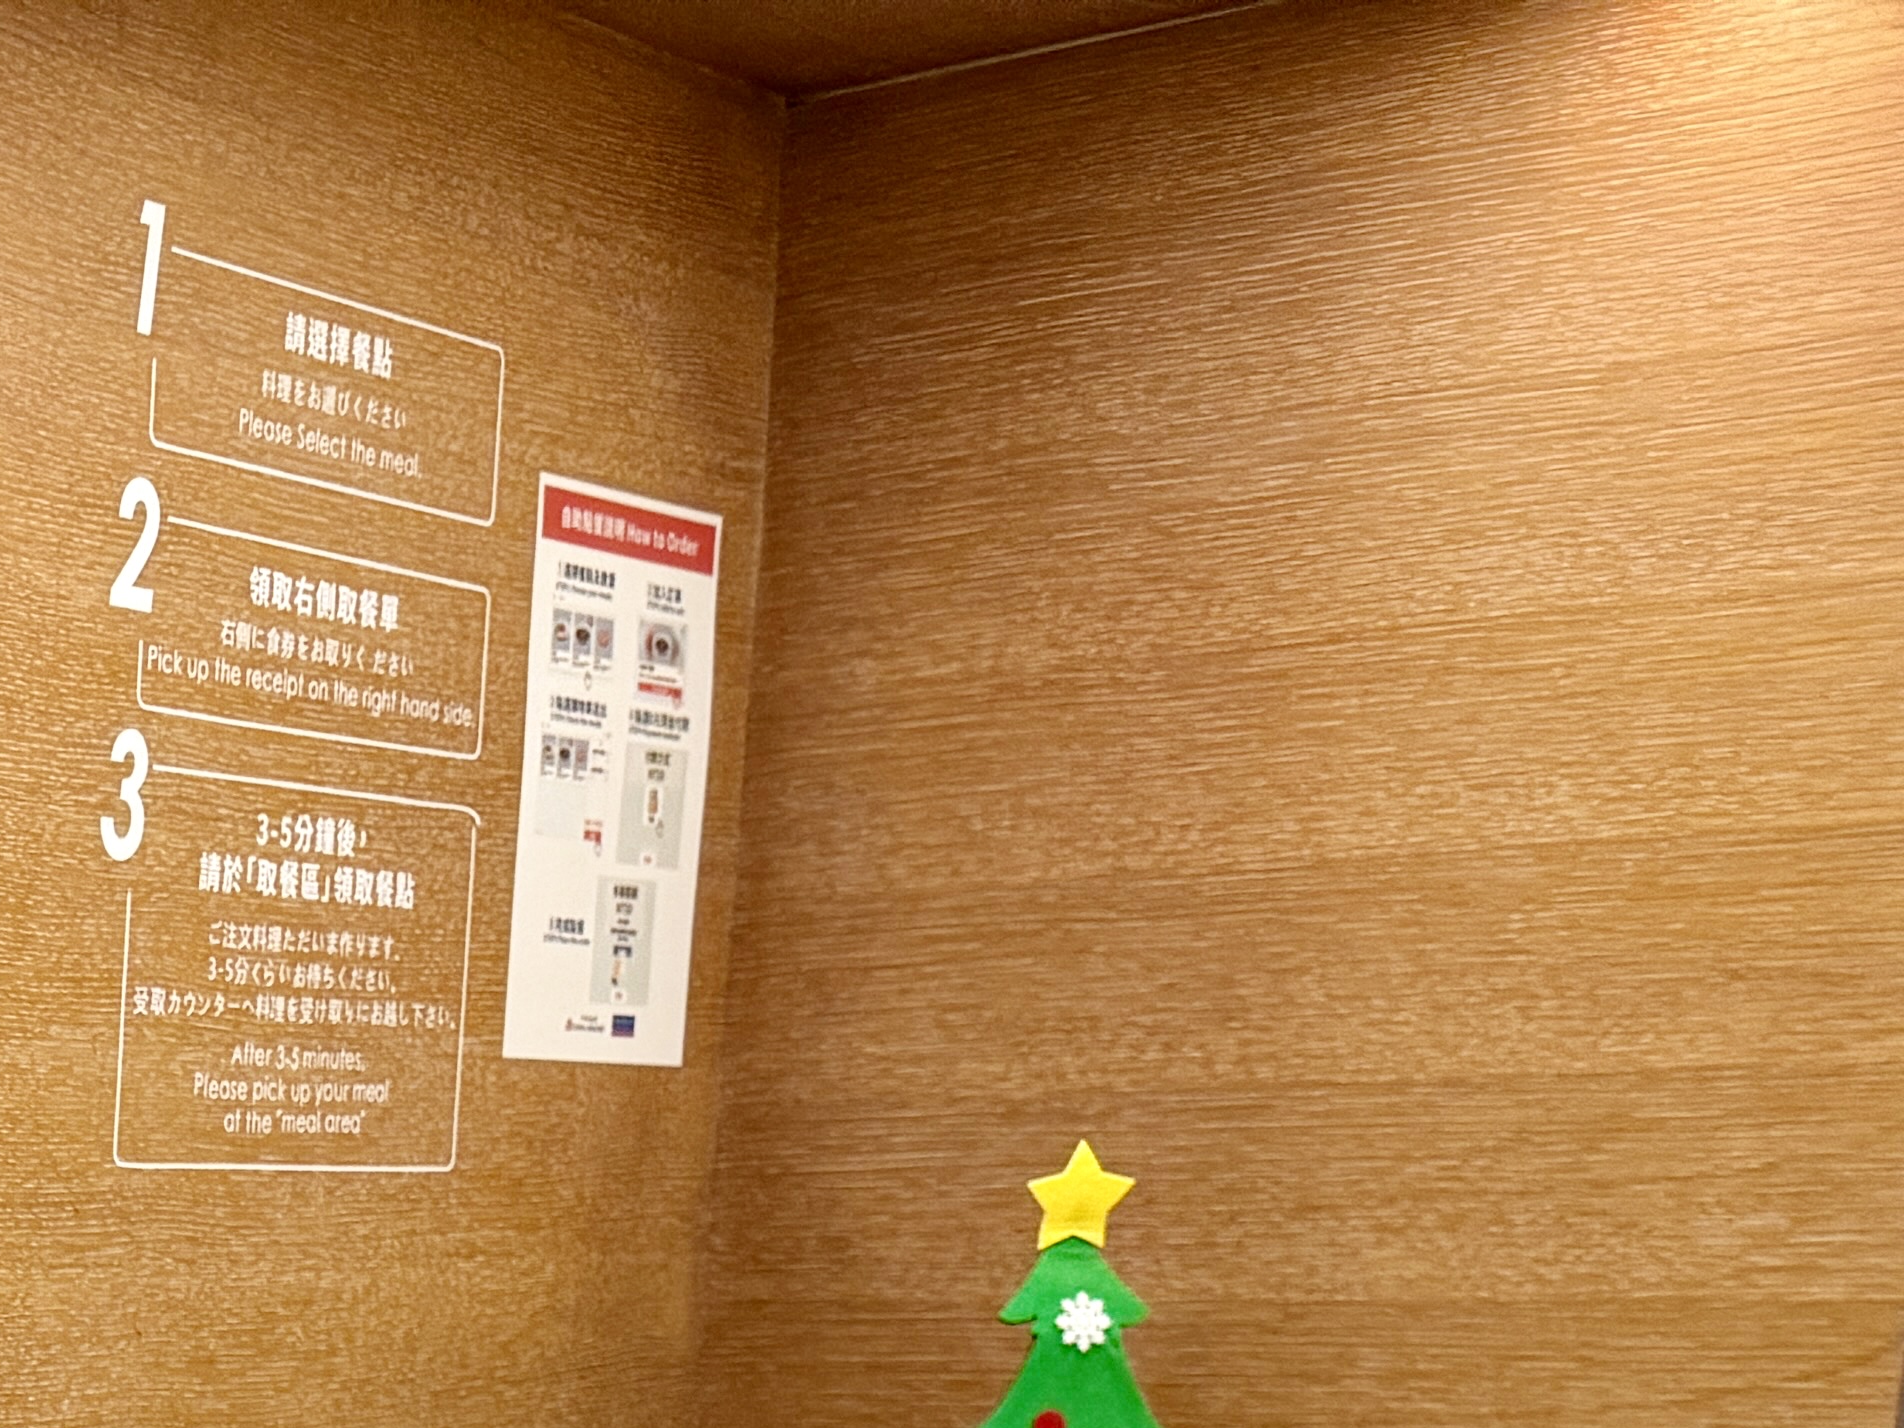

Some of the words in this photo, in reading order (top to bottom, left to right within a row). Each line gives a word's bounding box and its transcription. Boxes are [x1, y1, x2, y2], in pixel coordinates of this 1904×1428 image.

[137, 199, 166, 335] 1
[285, 311, 393, 380] 請選擇餐點
[262, 368, 406, 429] 料理をお選びください
[239, 407, 292, 445] Please
[297, 423, 346, 459] Select
[351, 436, 376, 467] the
[379, 450, 423, 479] meal.
[109, 477, 161, 613] 2
[249, 565, 399, 633] 領取右側取餐單
[147, 644, 182, 675] Pick
[187, 656, 209, 685] up
[215, 656, 241, 687] the
[246, 667, 304, 701] receipt
[309, 679, 328, 701] on
[334, 679, 358, 707] the
[362, 685, 396, 718] right
[400, 690, 440, 722] hand
[100, 728, 149, 861] 3
[193, 1071, 248, 1101] Please
[252, 1075, 286, 1105] pick
[291, 1082, 311, 1107] up
[315, 1081, 350, 1107] your
[352, 1079, 391, 1104] meal
[231, 1041, 273, 1067] After
[276, 1044, 300, 1071] 3-5
[223, 1108, 241, 1134] at
[246, 1110, 272, 1135] the
